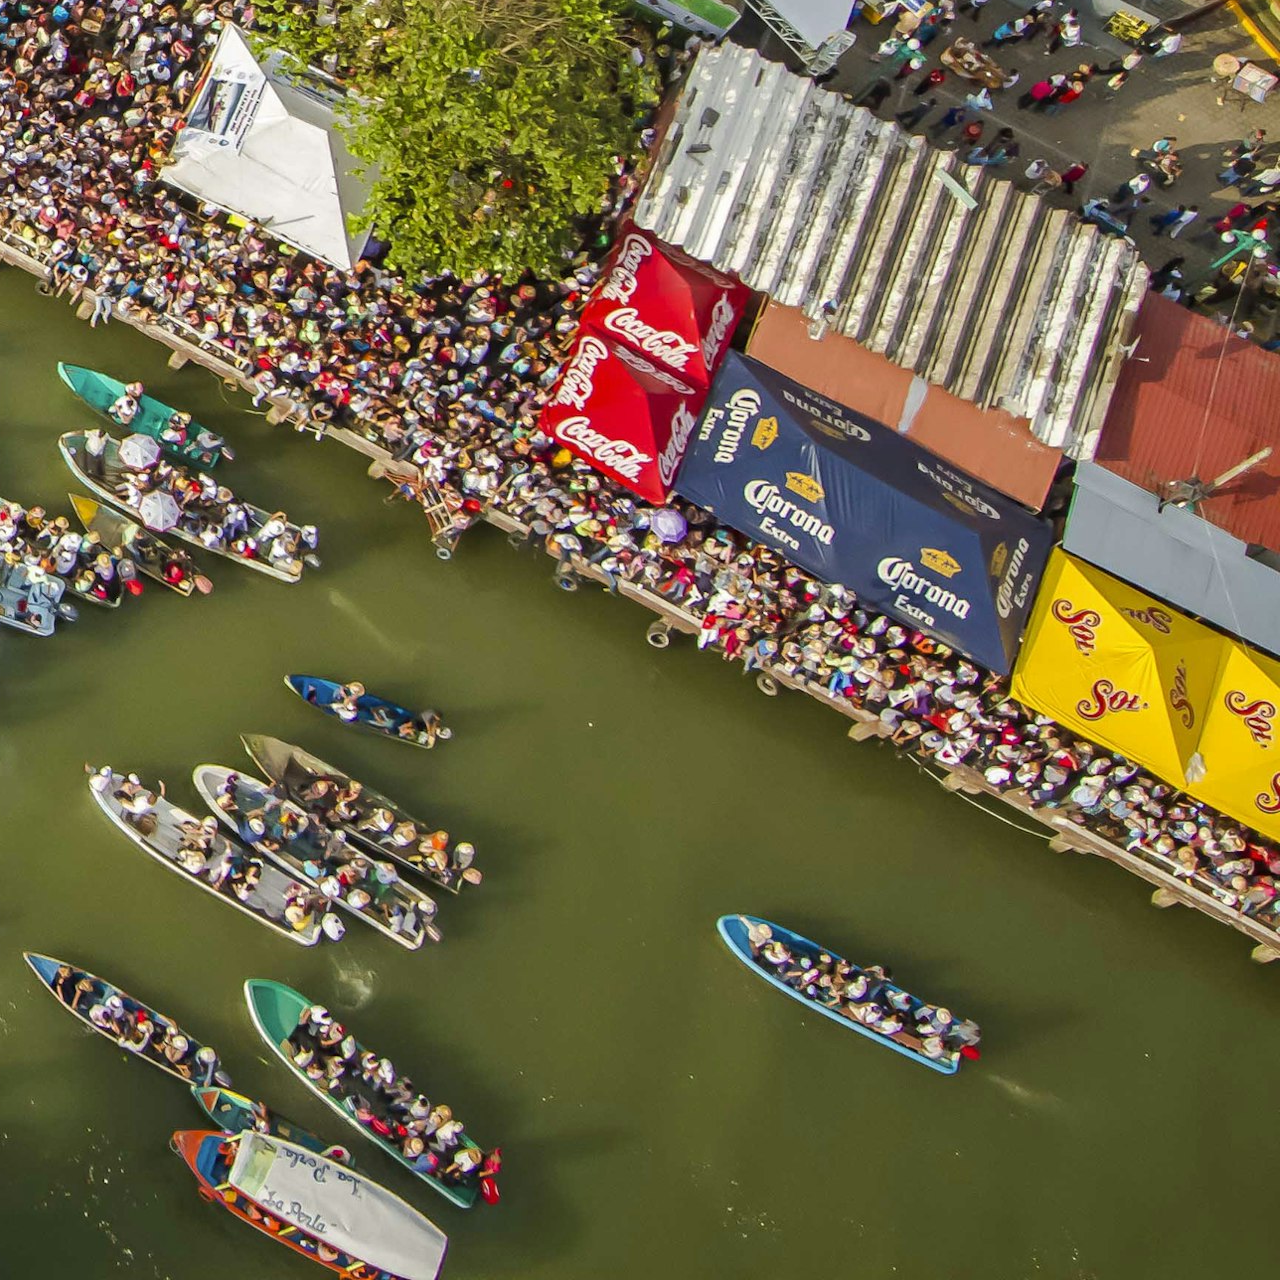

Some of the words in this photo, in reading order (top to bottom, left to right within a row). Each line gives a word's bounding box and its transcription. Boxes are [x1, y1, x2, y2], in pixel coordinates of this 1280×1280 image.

[602, 233, 653, 306] Coca-Cola
[604, 307, 700, 373] Coca-Cola
[549, 336, 609, 412] Coca-Cola
[698, 408, 725, 441] Extra
[713, 388, 762, 464] Corona
[782, 389, 872, 442] Corona
[555, 416, 654, 484] Coca-Cola
[743, 479, 836, 545] Corona
[916, 461, 1001, 520] Corona
[759, 516, 800, 550] Extra
[877, 556, 972, 621] Corona
[995, 536, 1031, 619] Corona
[1013, 573, 1033, 609] Extra
[893, 595, 935, 627] Extra
[282, 1146, 330, 1183] Perla
[336, 1170, 361, 1196] La
[261, 1191, 284, 1212] La
[285, 1201, 327, 1234] Perla
